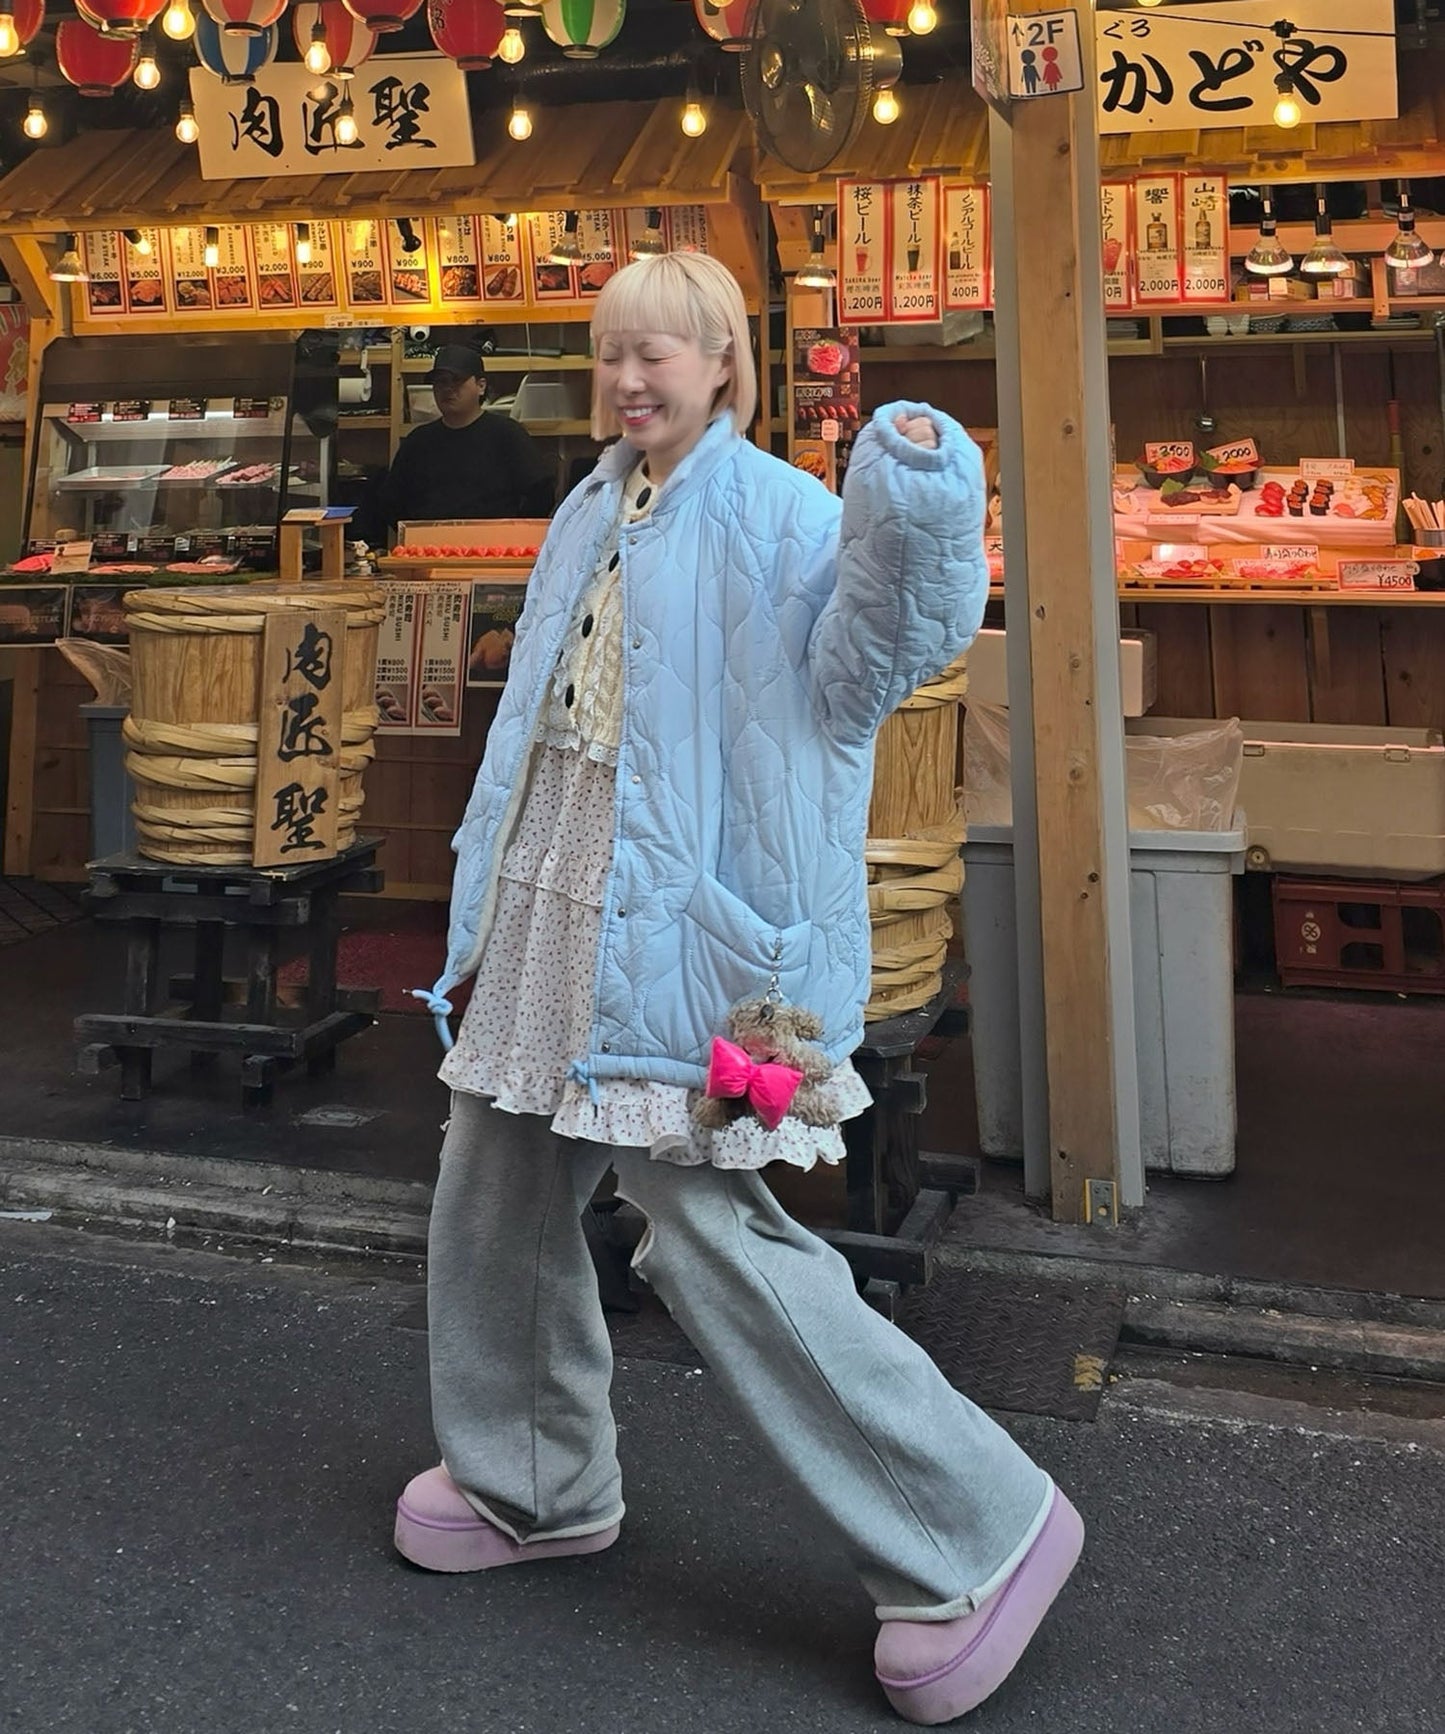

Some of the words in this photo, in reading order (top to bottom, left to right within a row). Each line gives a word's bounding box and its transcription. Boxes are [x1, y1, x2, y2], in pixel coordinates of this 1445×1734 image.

[1027, 19, 1064, 46] 2F
[1103, 19, 1151, 40] ぐろ
[1100, 39, 1347, 114] かどや
[228, 75, 437, 158] 肉匠聖
[853, 186, 872, 245] 桜ビール
[907, 184, 923, 244] 抹茶ビール
[960, 194, 975, 270] ノンアルコールビール
[351, 260, 374, 268] ¥900
[396, 258, 419, 267] ¥900
[447, 255, 469, 263] ¥800
[488, 254, 511, 262] ¥800
[952, 287, 979, 298] 400円
[271, 622, 333, 854] 肉匠聖
